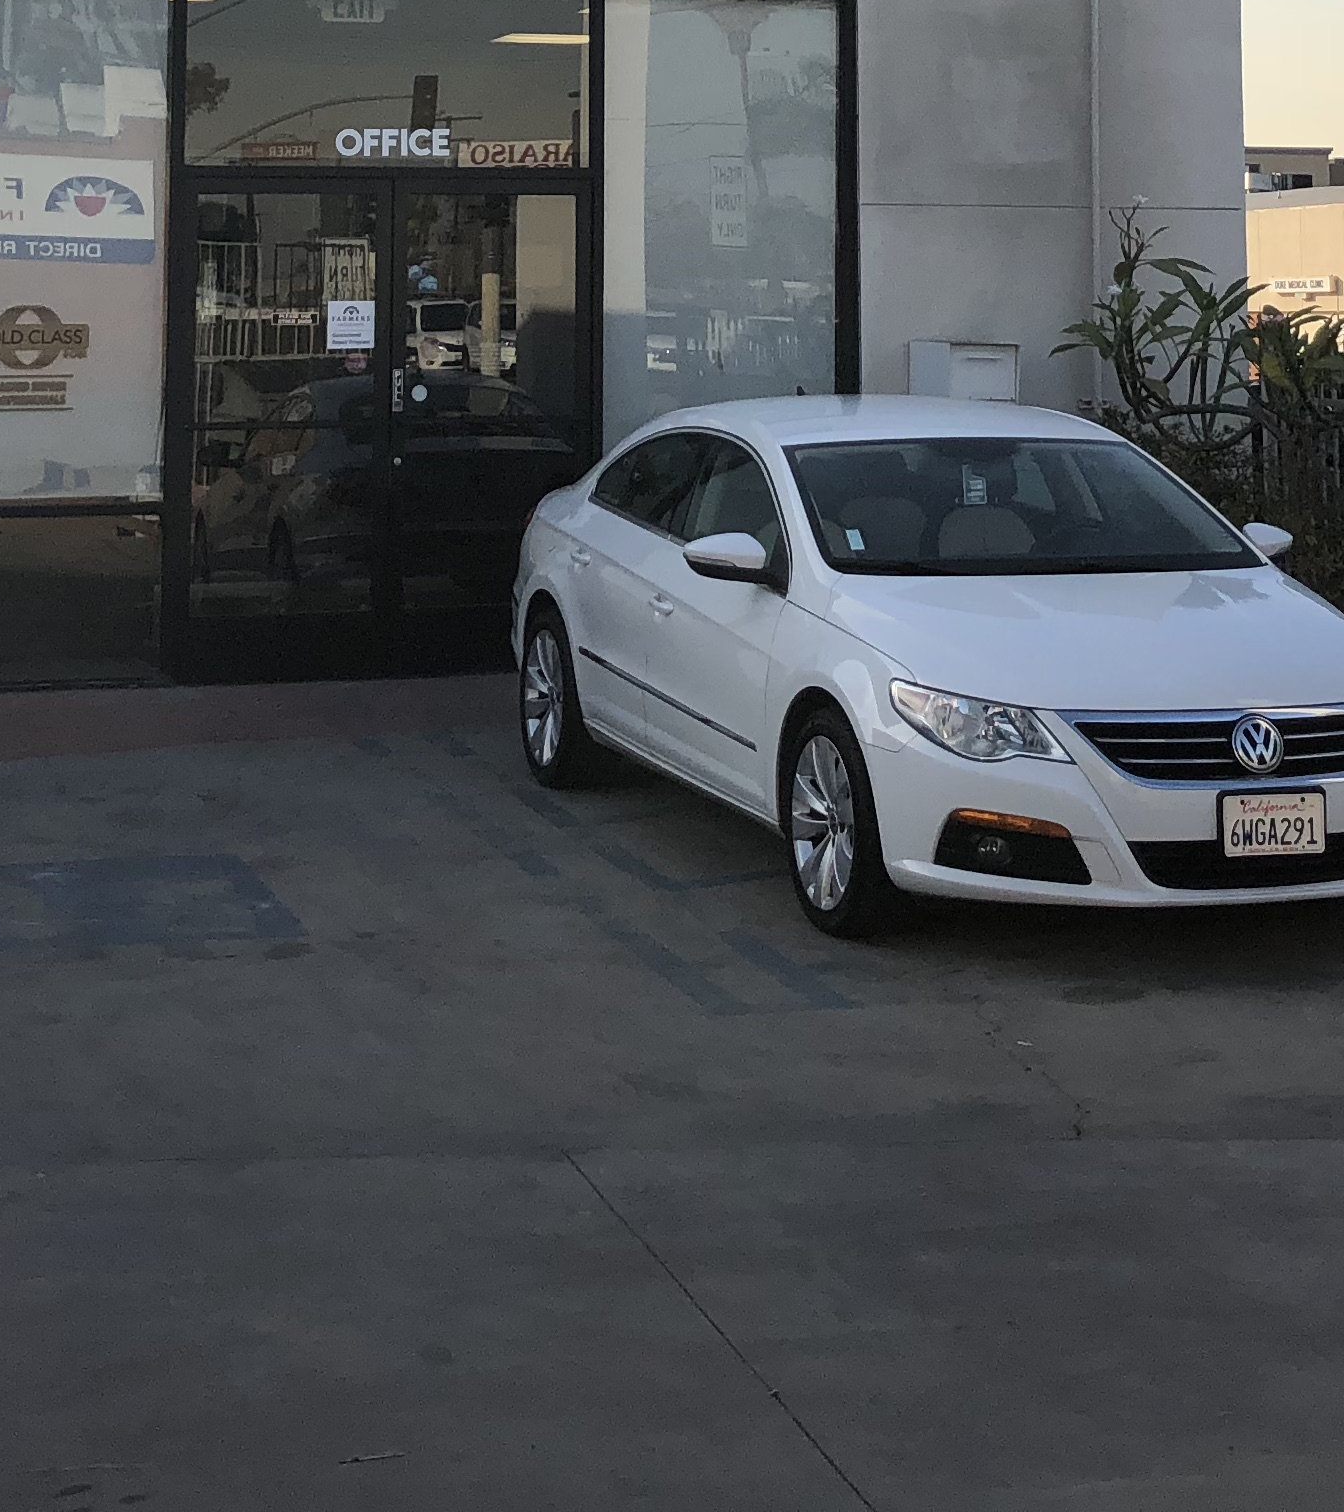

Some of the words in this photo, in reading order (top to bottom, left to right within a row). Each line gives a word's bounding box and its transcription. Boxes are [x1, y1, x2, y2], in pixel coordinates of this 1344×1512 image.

[335, 128, 450, 157] OFFICE
[1288, 280, 1308, 289] MEDICAL
[1310, 279, 1324, 289] CLINIC
[29, 329, 83, 345] CLASS
[1243, 799, 1306, 817] California
[1231, 817, 1318, 847] 6WGA291
